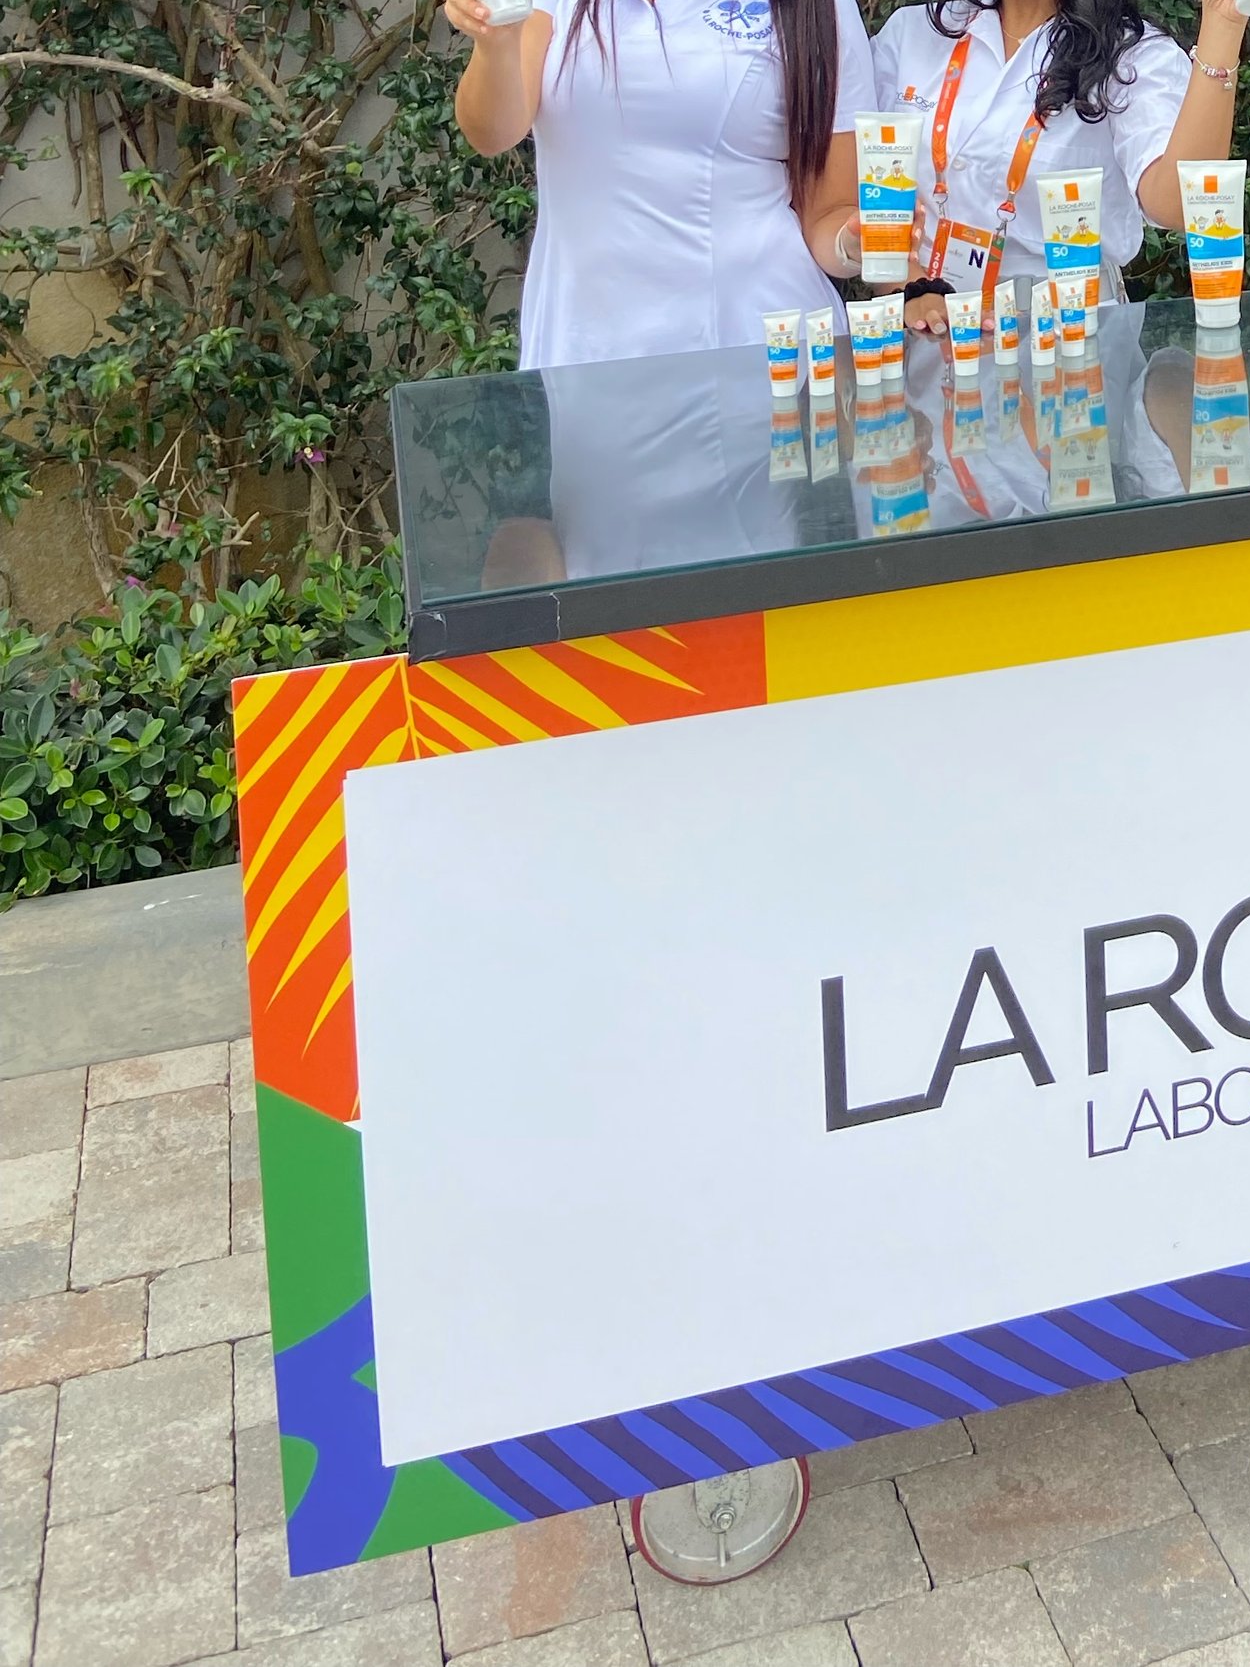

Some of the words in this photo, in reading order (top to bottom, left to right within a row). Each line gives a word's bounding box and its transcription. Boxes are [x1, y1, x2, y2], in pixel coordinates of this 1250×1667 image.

[865, 188, 880, 198] 50
[1189, 237, 1204, 248] 50
[1052, 246, 1068, 257] 50
[968, 248, 985, 269] N
[821, 946, 1055, 1133] LA
